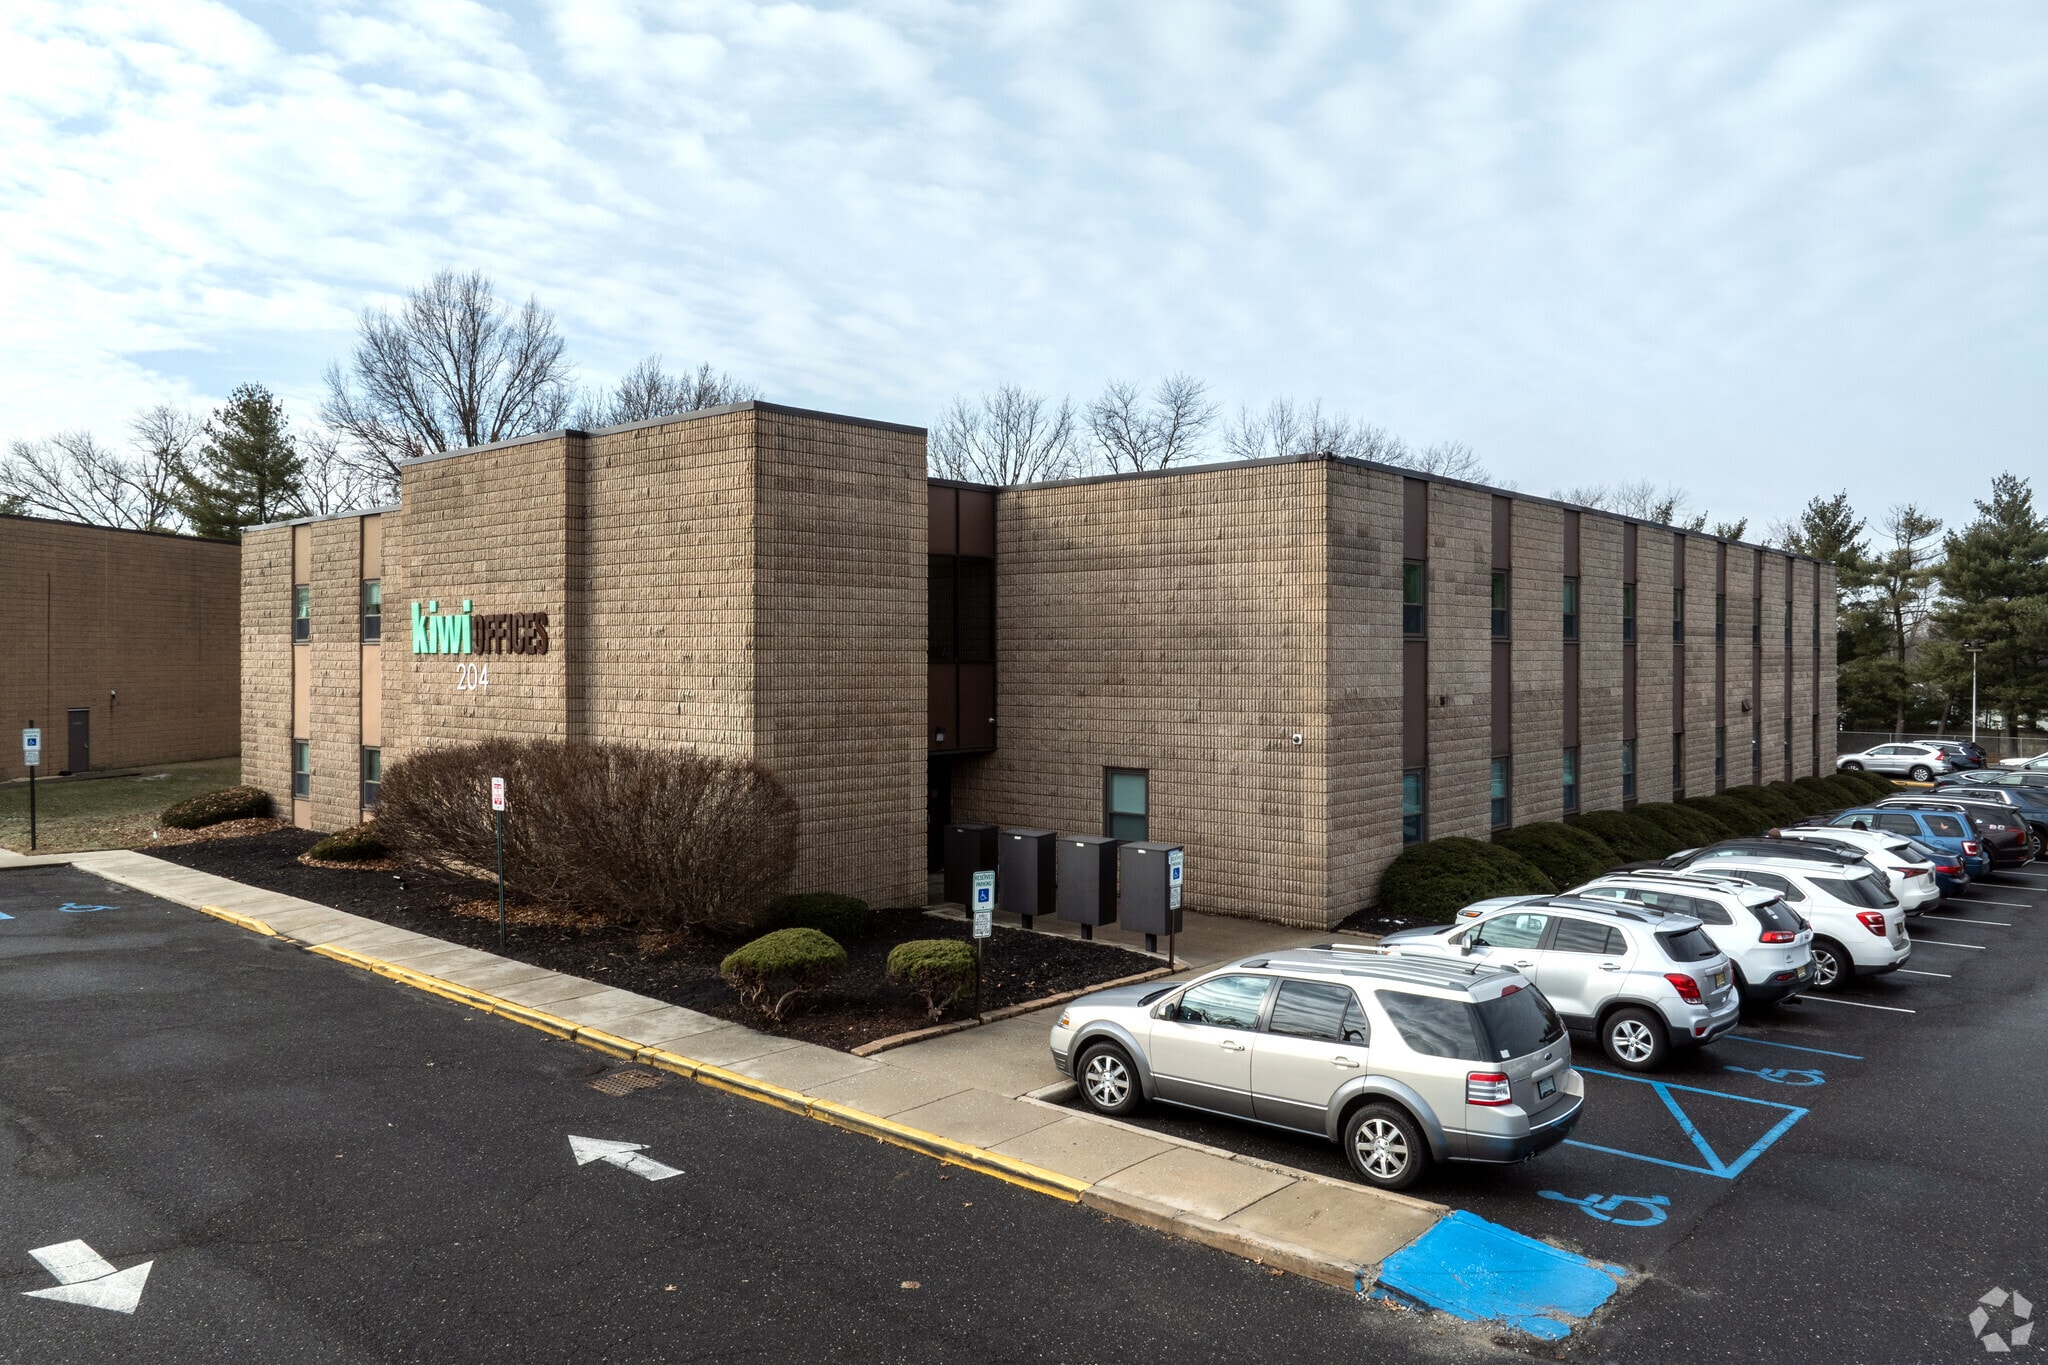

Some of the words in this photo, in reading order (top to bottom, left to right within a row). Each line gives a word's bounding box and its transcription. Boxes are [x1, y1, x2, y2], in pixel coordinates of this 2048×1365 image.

[411, 599, 472, 655] kiwi
[472, 612, 549, 655] OFFICES
[456, 662, 489, 691] 204
